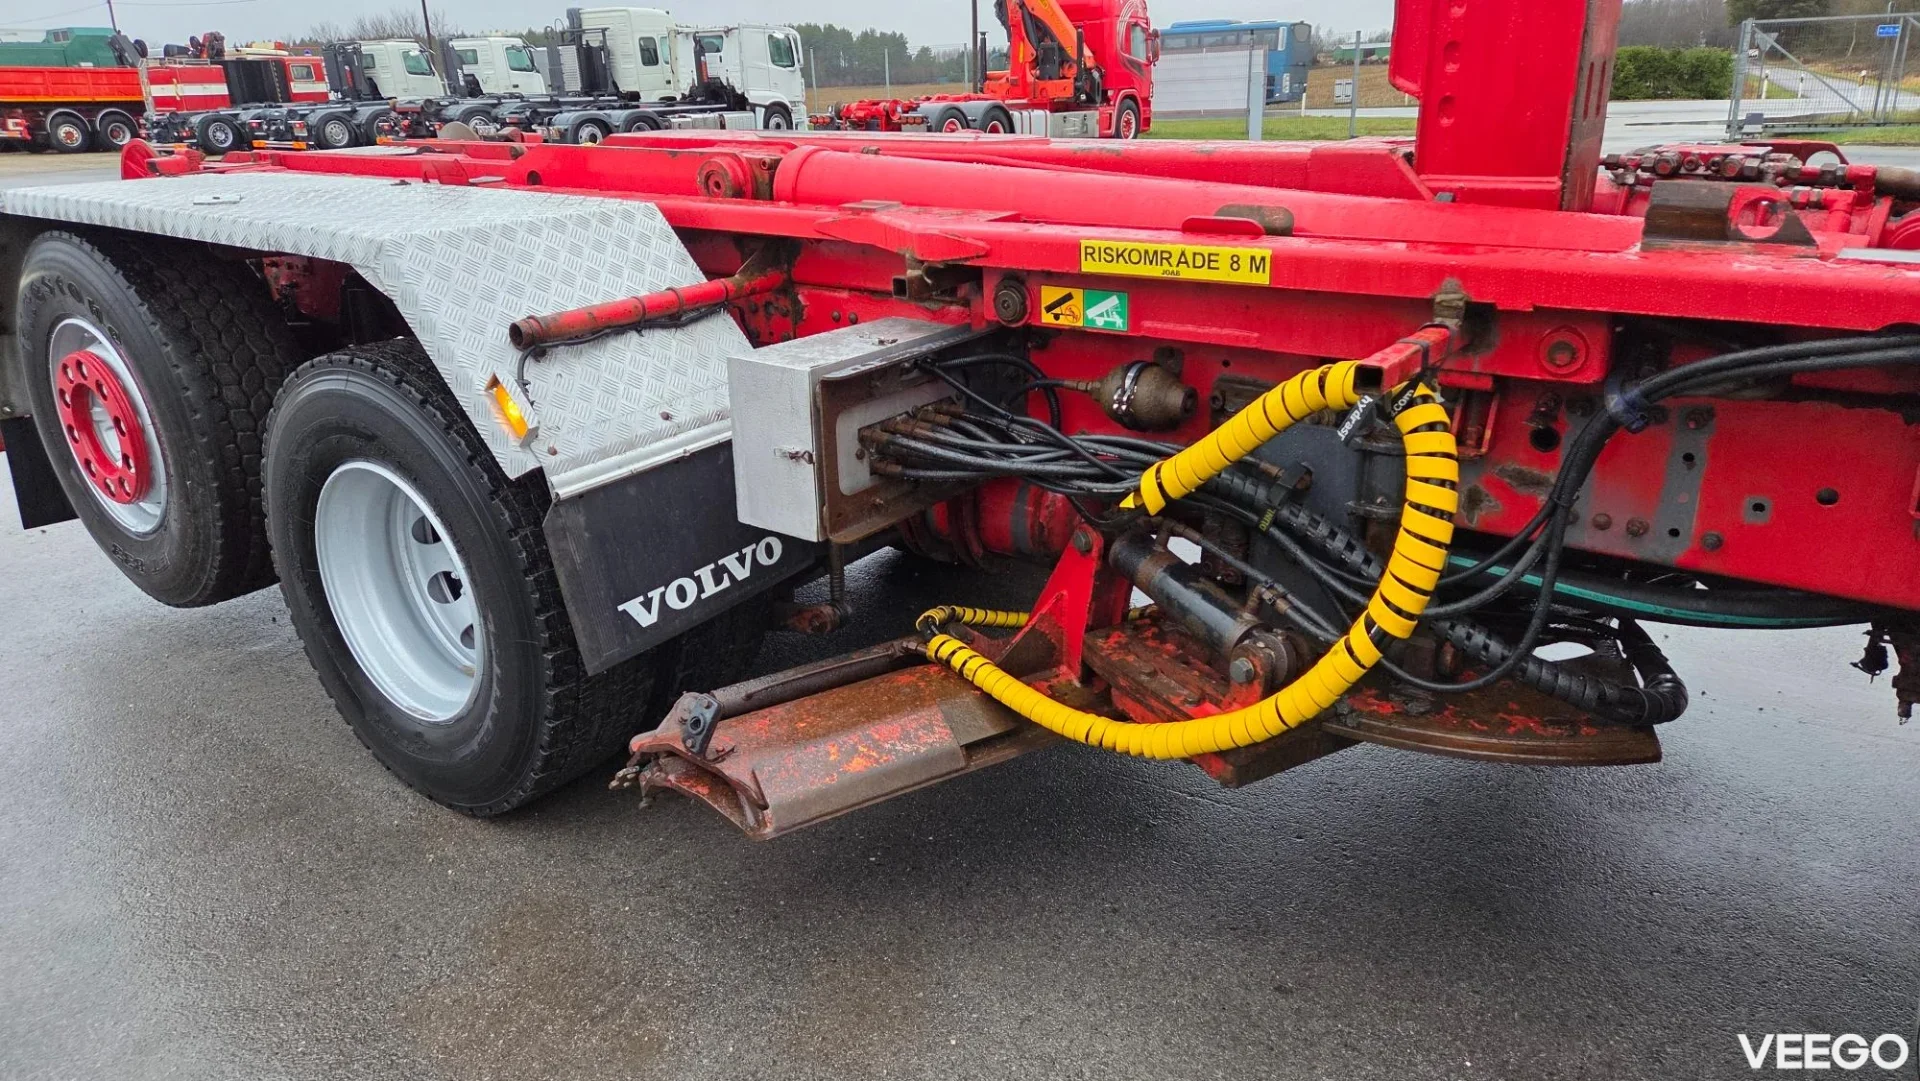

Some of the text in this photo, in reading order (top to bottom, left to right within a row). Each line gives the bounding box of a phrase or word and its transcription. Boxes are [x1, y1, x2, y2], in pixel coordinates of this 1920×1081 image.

[1084, 245, 1267, 274] RISKOMRÅDE 8 M
[1161, 269, 1181, 277] JOAB
[616, 536, 783, 628] VOLVO
